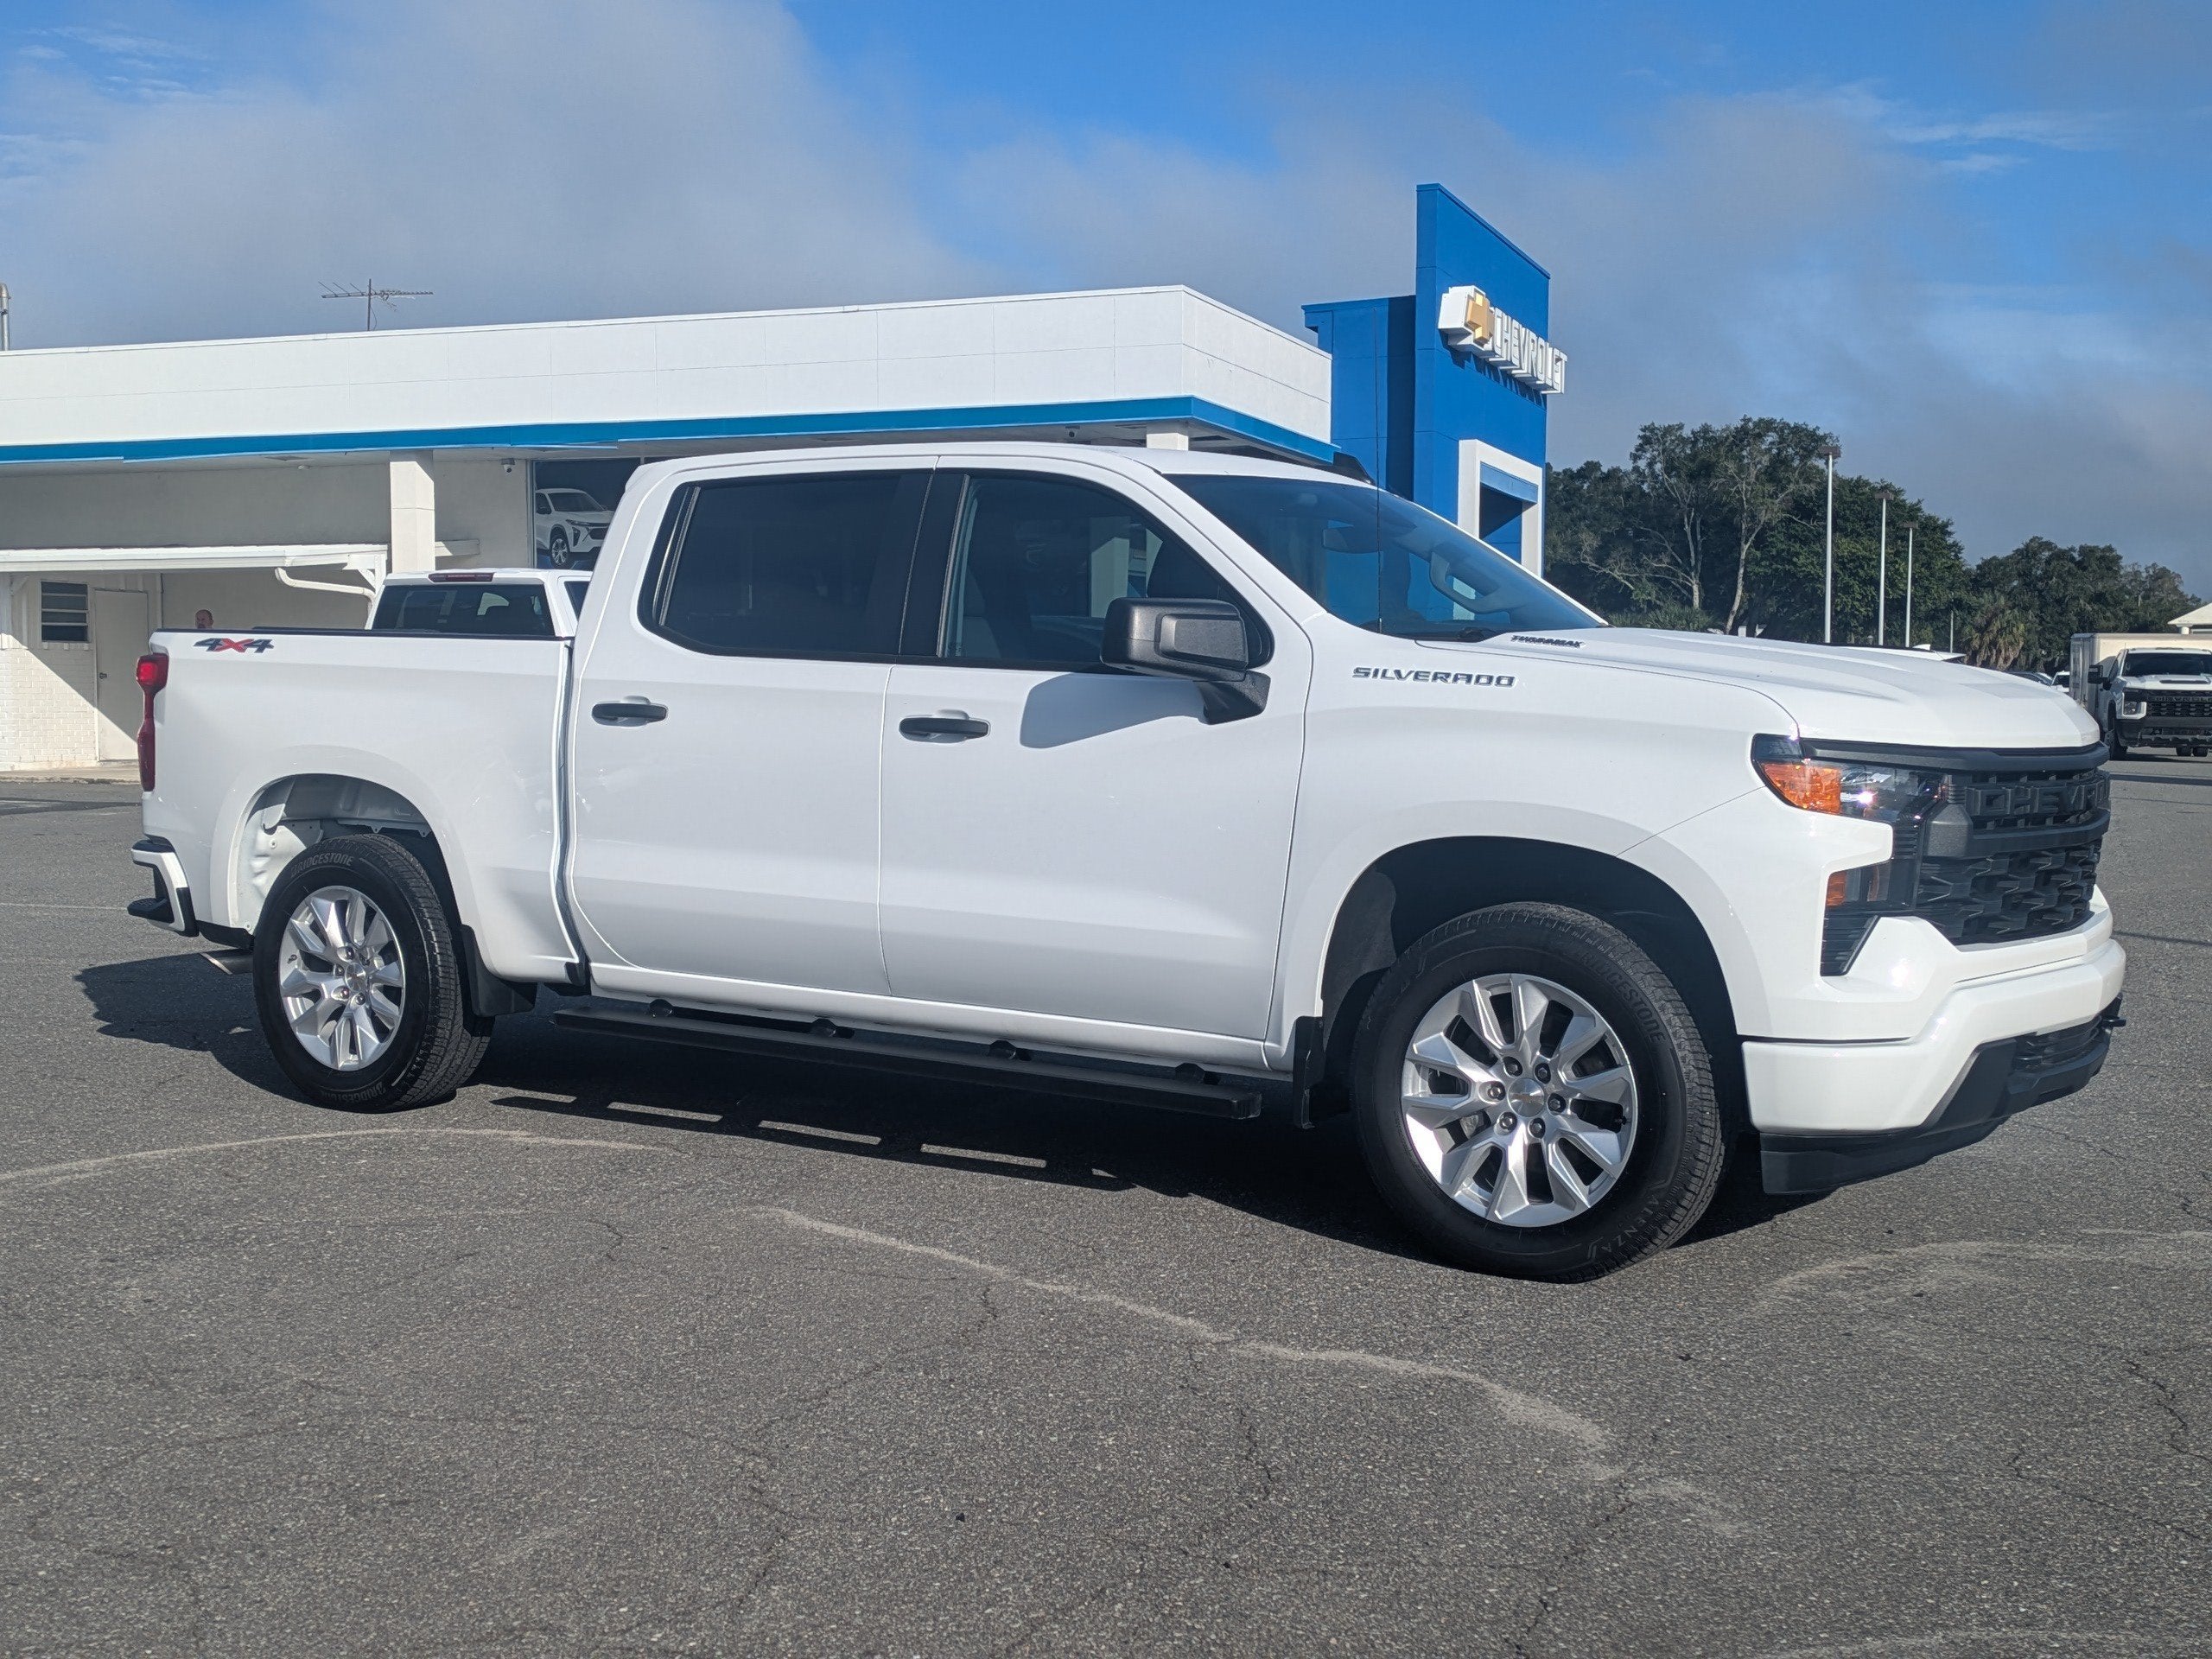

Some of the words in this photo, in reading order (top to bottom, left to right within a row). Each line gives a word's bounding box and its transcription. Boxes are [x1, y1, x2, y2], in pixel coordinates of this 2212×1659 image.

[1492, 307, 1567, 394] CHEVROLET
[1352, 666, 1516, 687] SILVERADO
[291, 853, 354, 878] BRIDGESTONE
[1601, 1195, 1660, 1252] ALENZA
